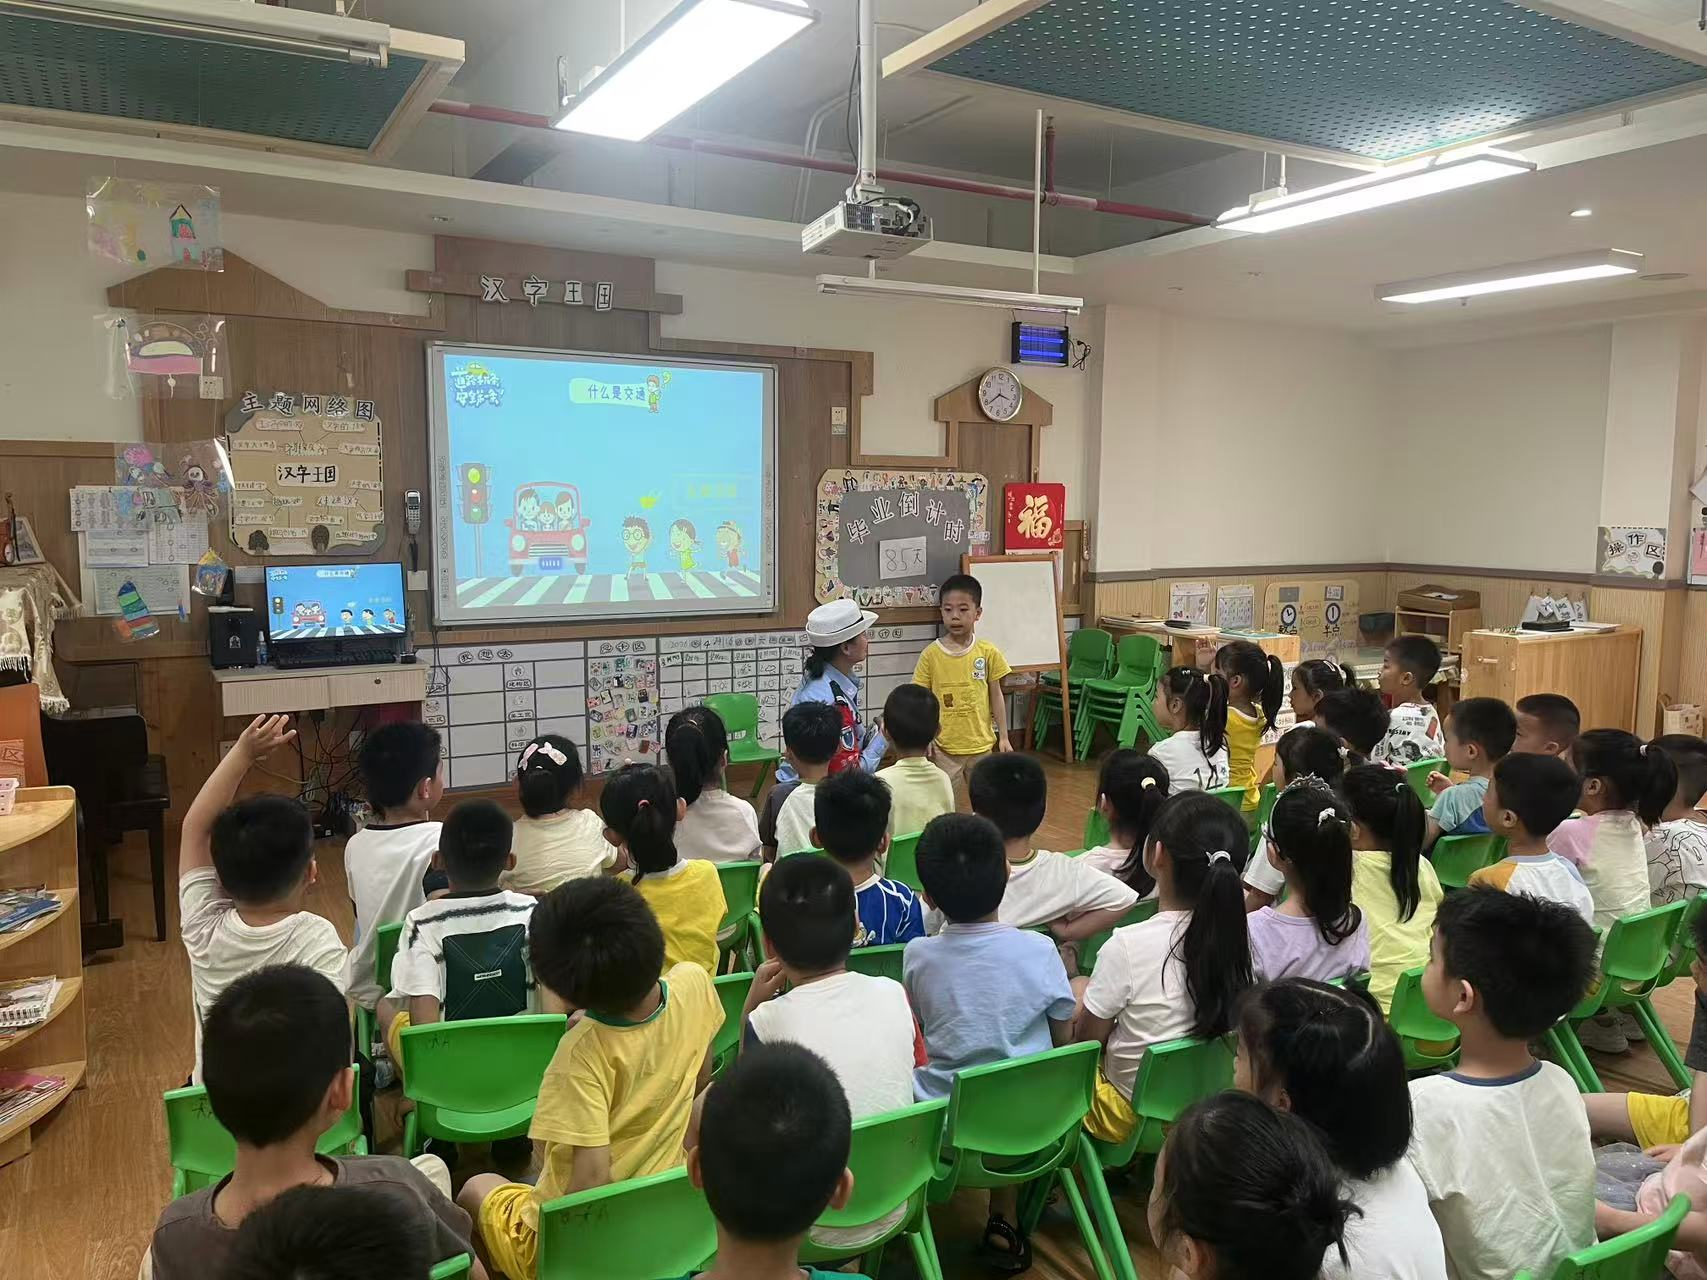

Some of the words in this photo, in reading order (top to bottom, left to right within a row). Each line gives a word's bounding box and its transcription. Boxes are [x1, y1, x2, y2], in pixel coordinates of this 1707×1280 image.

[482, 277, 613, 309] 汉字王国
[998, 373, 1005, 381] 12
[587, 383, 647, 401] 什么是交通
[982, 389, 987, 397] 9
[242, 392, 374, 420] 主题网络图
[277, 464, 336, 483] 汉字王国
[847, 492, 964, 544] 毕业倒计时
[1017, 495, 1052, 538] 福
[1608, 534, 1662, 558] 操作区
[885, 547, 923, 572] 85天
[1322, 624, 1340, 638] 半点
